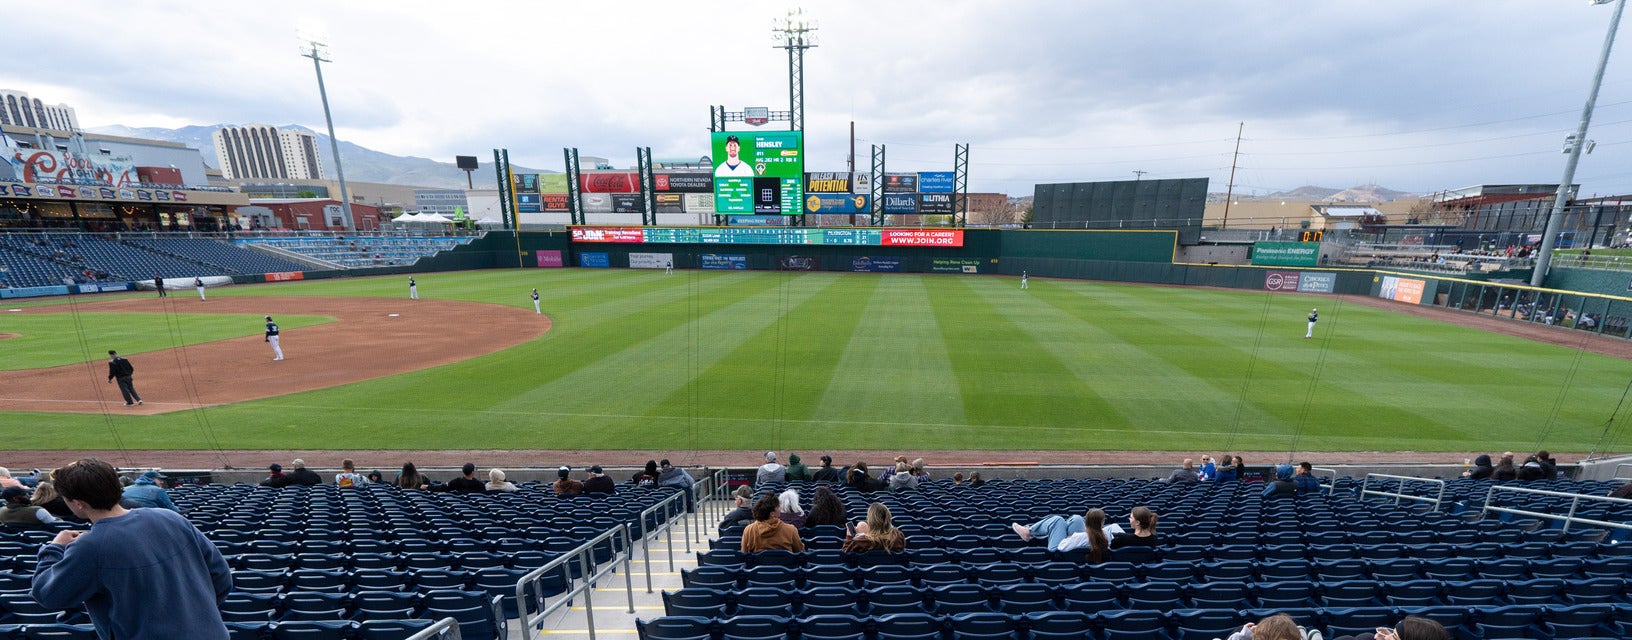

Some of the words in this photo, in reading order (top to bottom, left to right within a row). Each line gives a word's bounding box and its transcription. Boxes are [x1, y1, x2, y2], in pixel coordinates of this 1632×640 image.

[809, 180, 848, 192] POTENTIAL
[886, 197, 915, 206] Dillard's
[766, 217, 783, 225] Chill
[1303, 231, 1322, 242] 0:17
